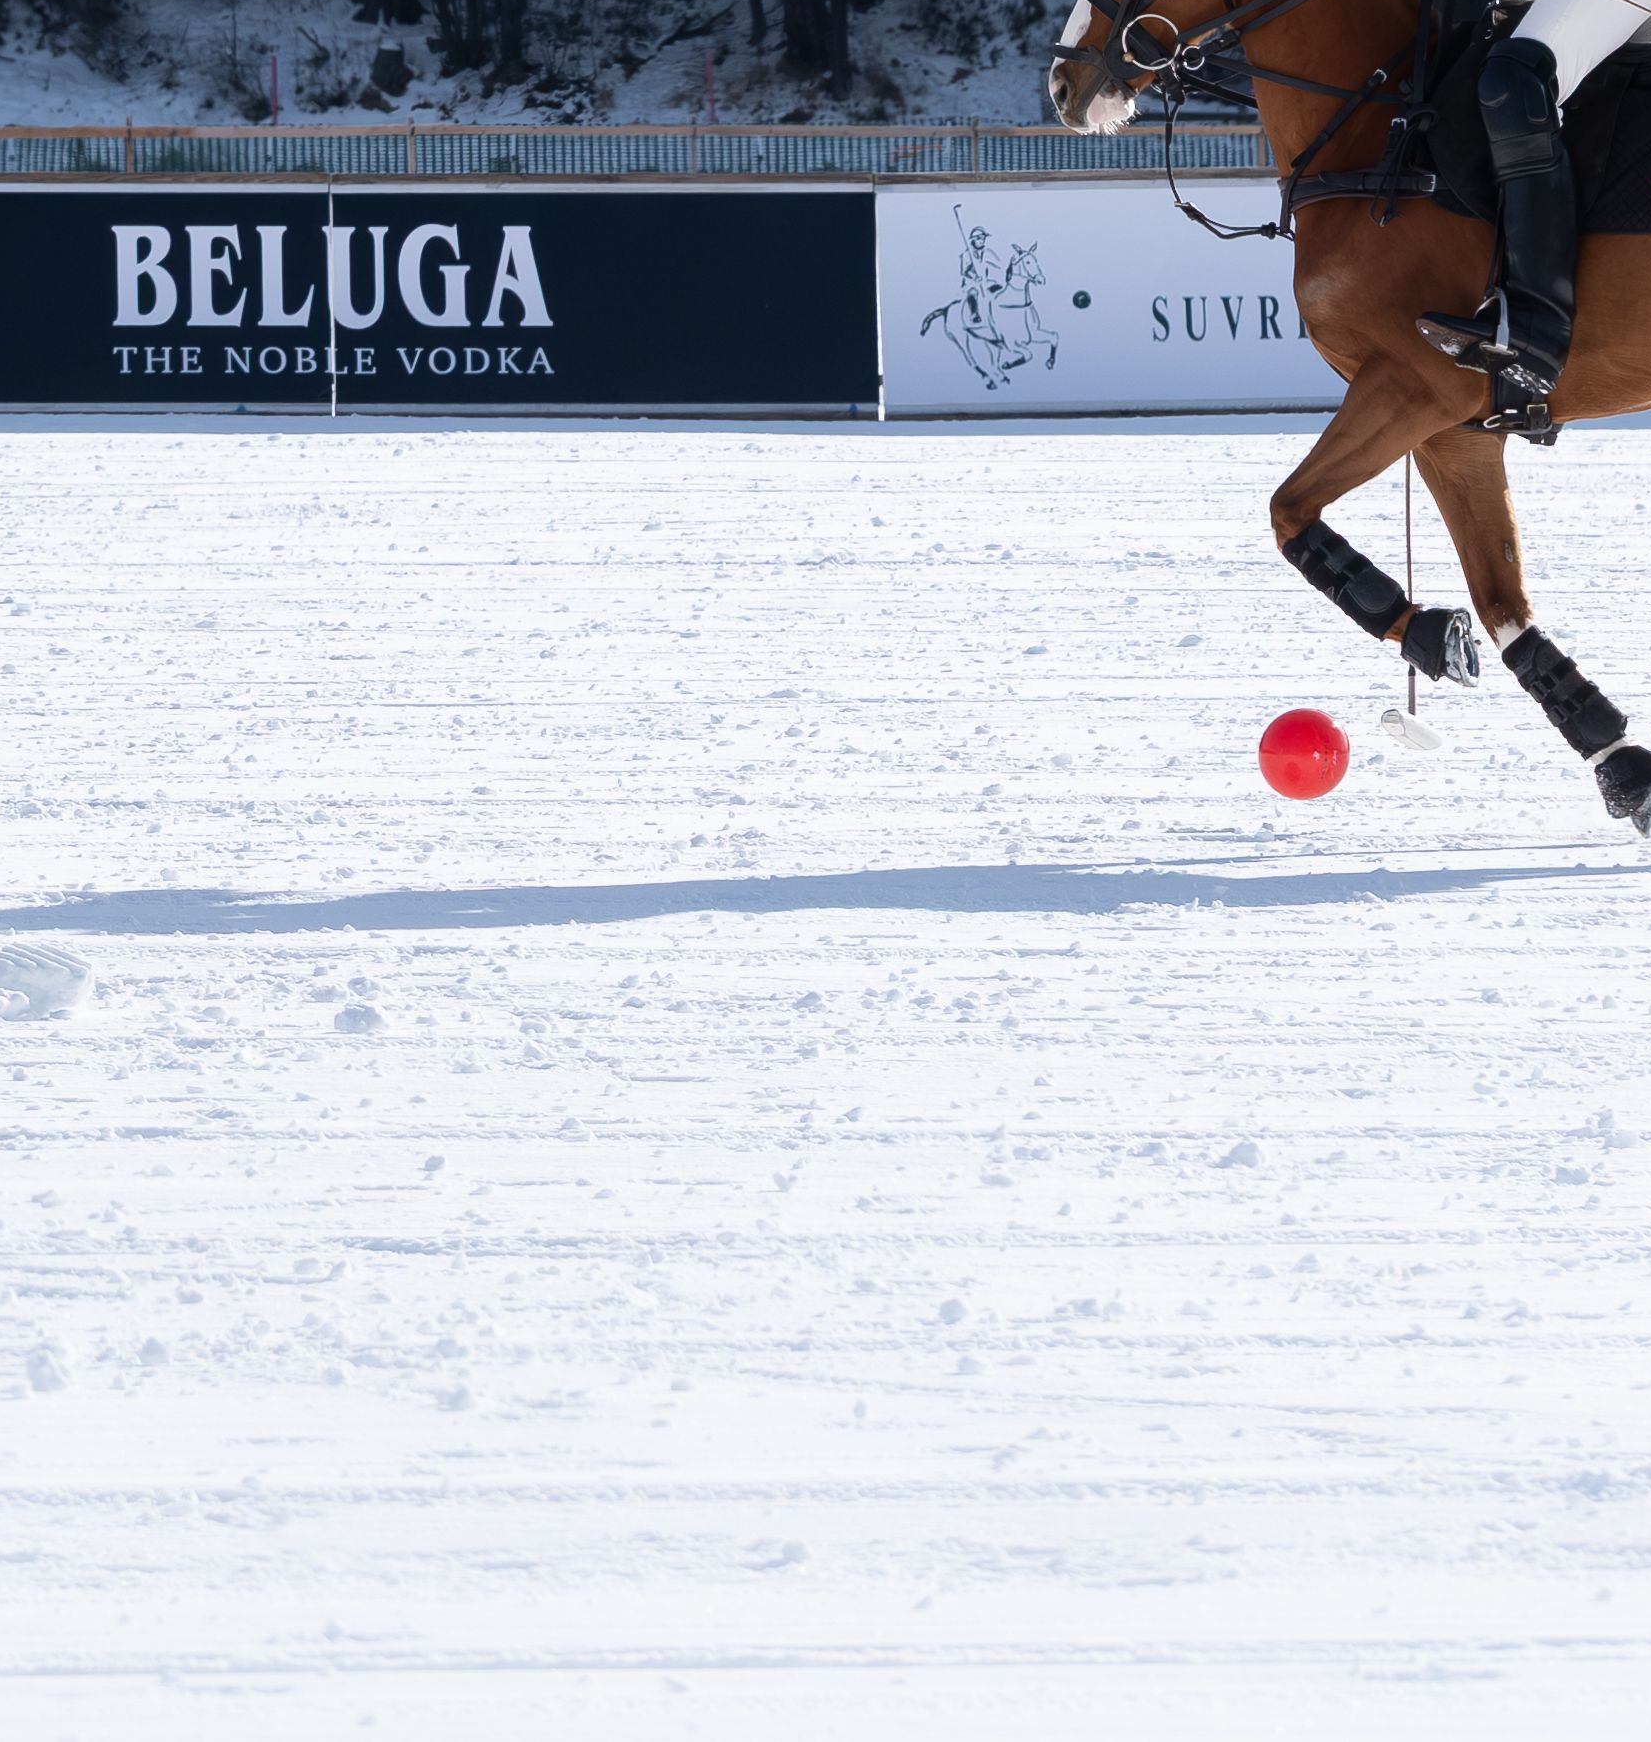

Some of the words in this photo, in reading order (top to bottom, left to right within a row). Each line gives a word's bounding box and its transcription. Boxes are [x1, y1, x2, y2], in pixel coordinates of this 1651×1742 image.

[110, 224, 554, 330] BELUGA
[112, 346, 203, 374] THE
[224, 346, 377, 375] NOBLE
[396, 346, 555, 375] VODKA
